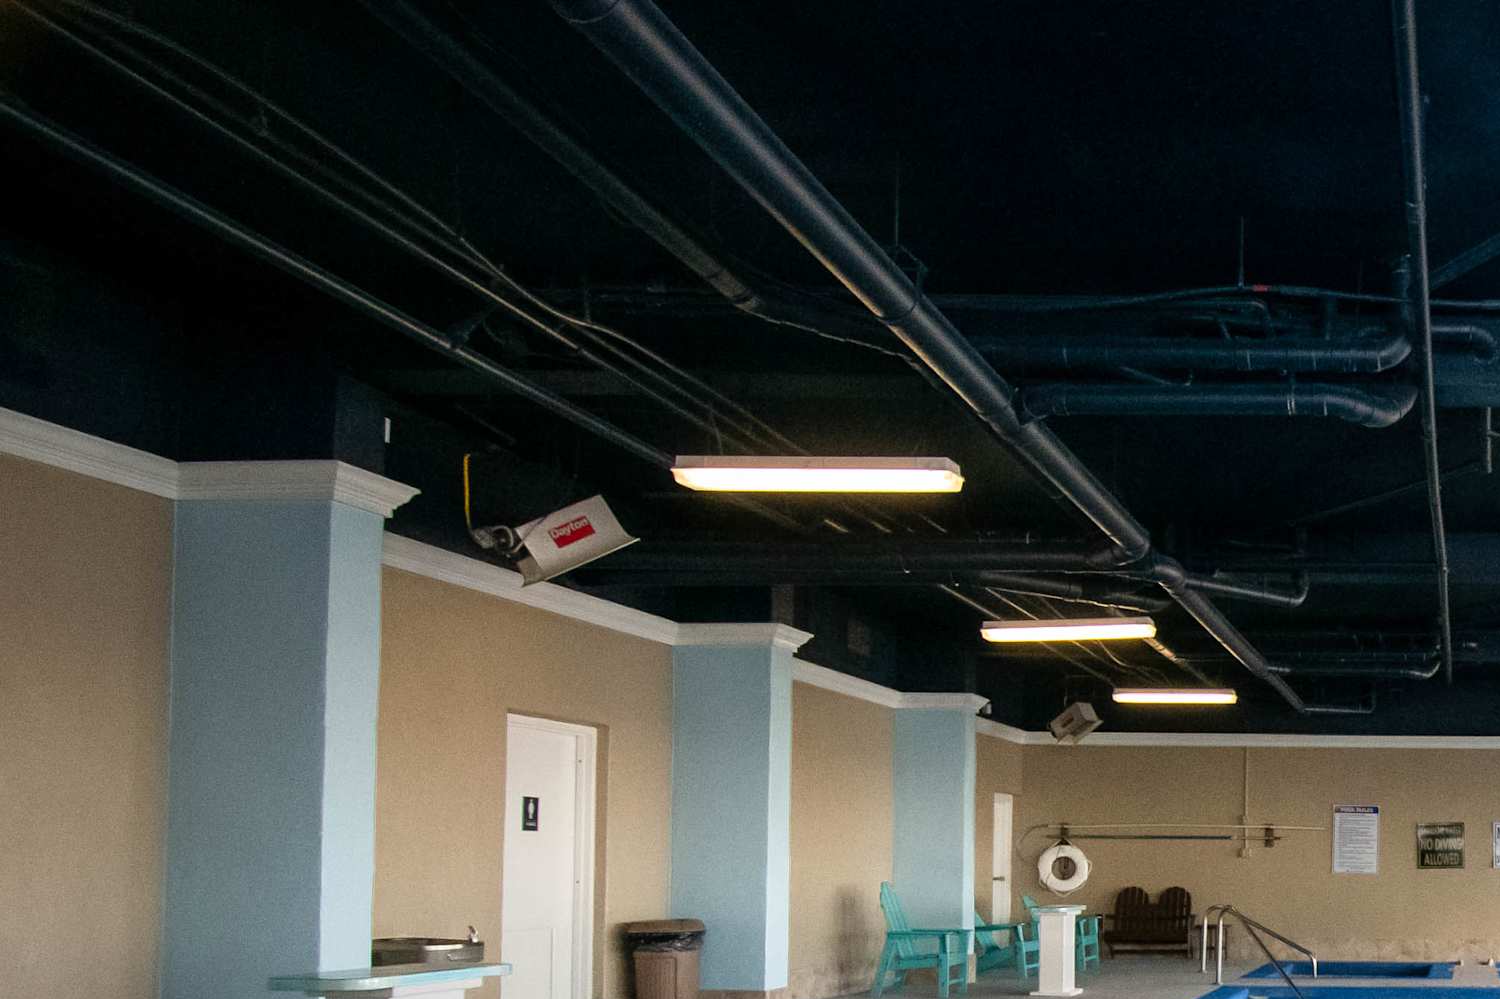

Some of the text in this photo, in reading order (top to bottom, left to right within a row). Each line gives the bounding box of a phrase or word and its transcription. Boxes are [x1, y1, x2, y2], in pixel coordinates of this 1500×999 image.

[551, 518, 588, 538] Dayton
[1420, 838, 1464, 850] NO DIVING
[1424, 852, 1460, 866] ALLOWED
